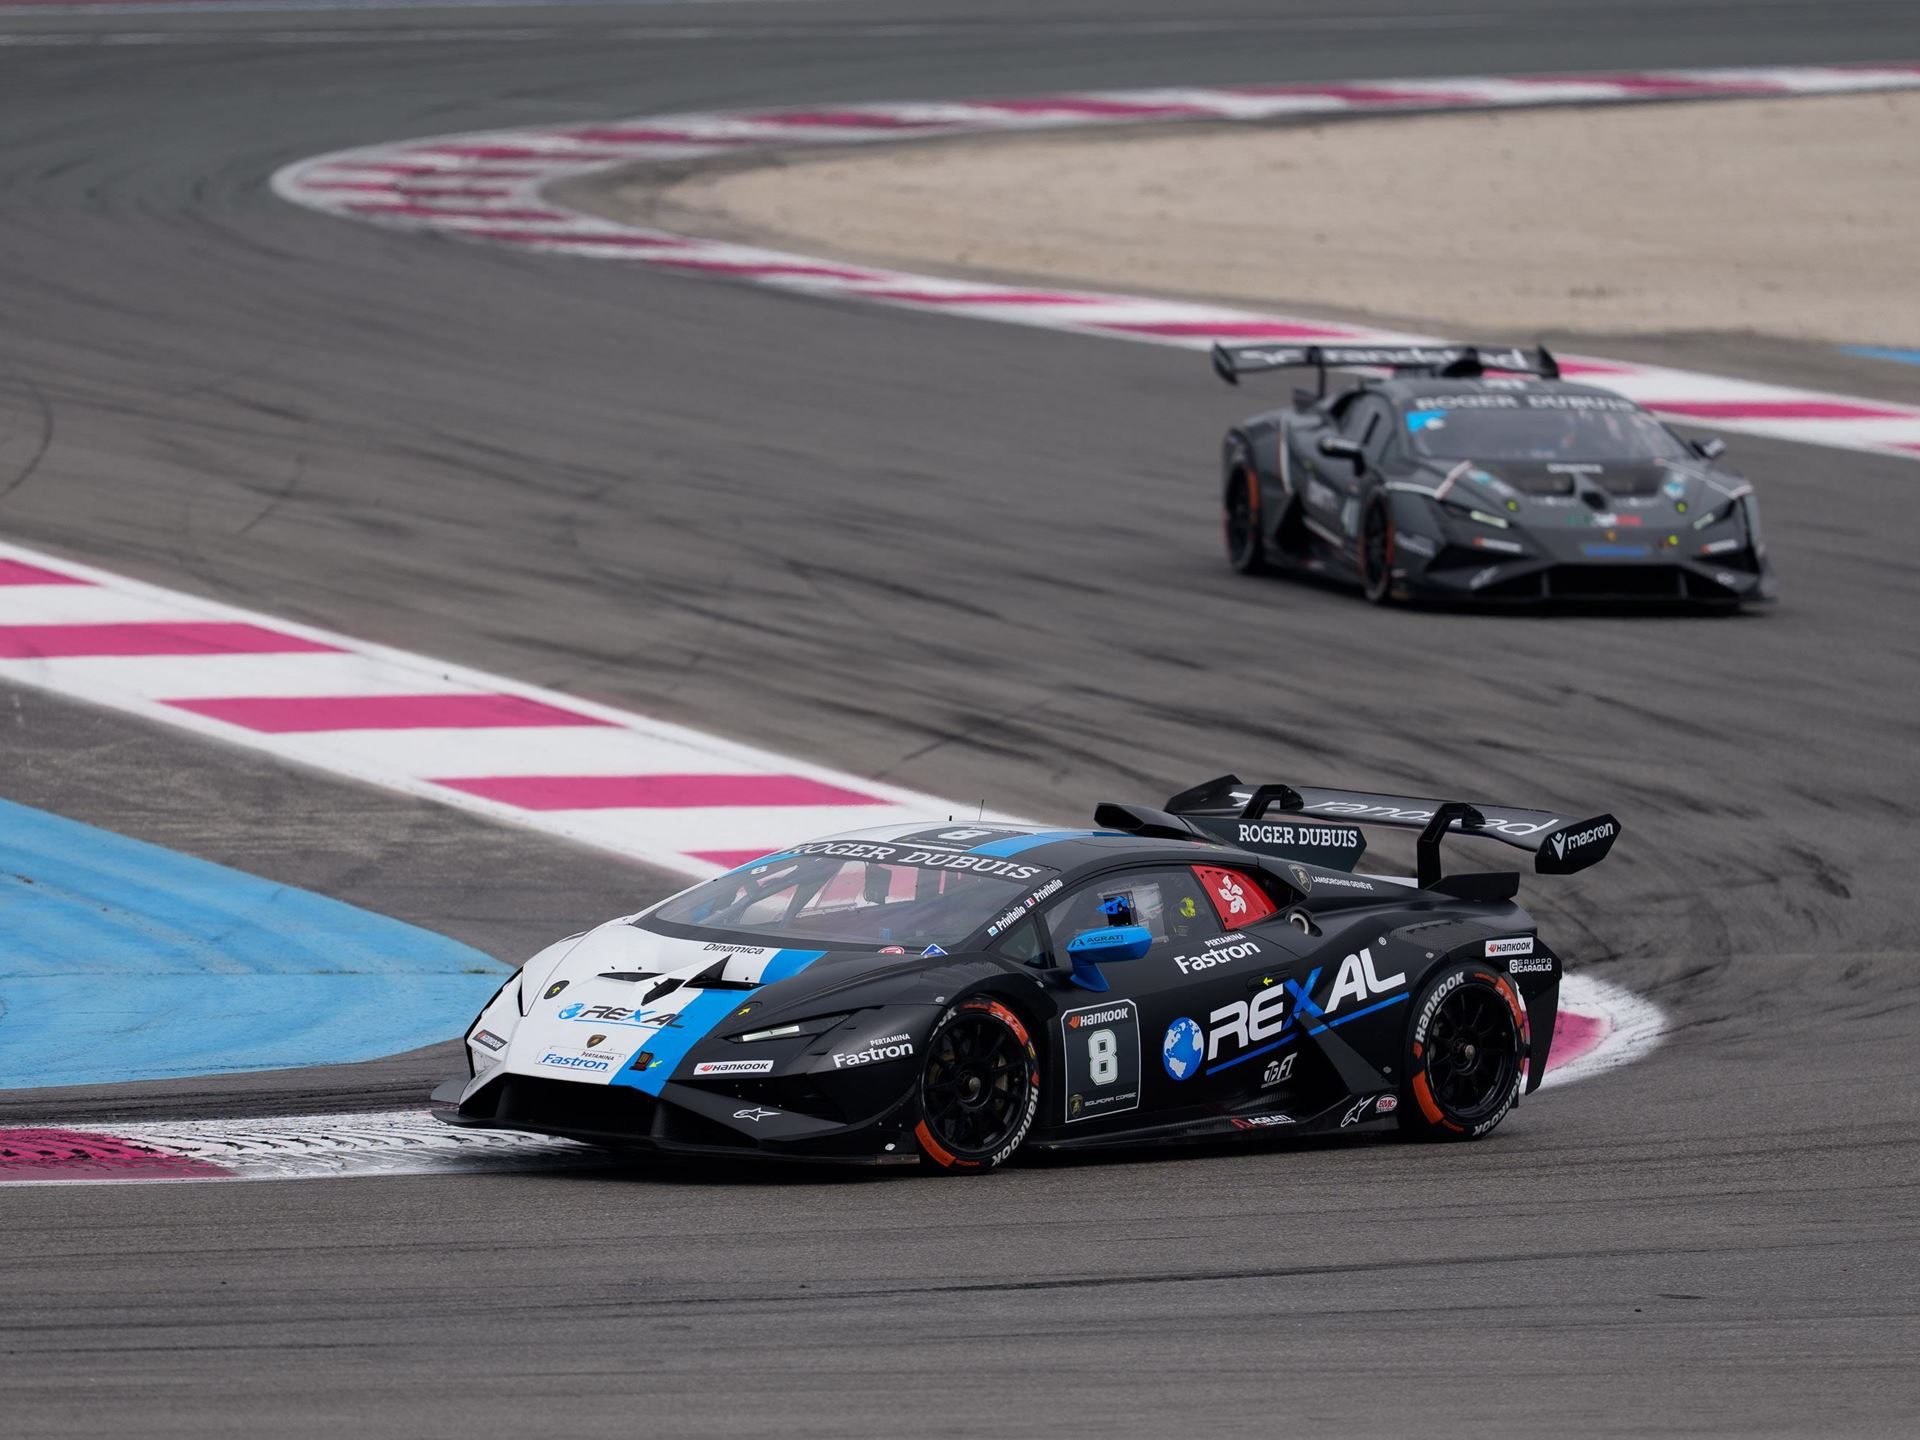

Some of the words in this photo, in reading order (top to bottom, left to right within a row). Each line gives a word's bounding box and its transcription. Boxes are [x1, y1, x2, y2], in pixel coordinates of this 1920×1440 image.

[1303, 801, 1560, 836] randad
[1238, 824, 1295, 845] ROGER
[1298, 828, 1358, 848] DUBUIS
[1567, 821, 1614, 850] macron
[785, 842, 896, 860] ROGER
[897, 850, 1040, 880] DUBUIS
[995, 905, 1026, 931] Privitello
[1032, 879, 1064, 902] Privitello
[702, 943, 765, 955] Dinamica
[1086, 934, 1124, 943] AGRATI
[1204, 932, 1246, 948] PERTAMINA
[1173, 941, 1262, 975] Fastron
[1518, 957, 1552, 966] GRUPPO
[1518, 964, 1552, 973] CARAGLIO
[1207, 948, 1407, 1061] REXAL
[578, 1005, 685, 1029] REXAL
[870, 1033, 911, 1047] PERTAMINA
[541, 1053, 609, 1071] Fastron
[581, 1051, 615, 1061] PERTAMINA
[832, 1042, 914, 1069] Fastron
[1087, 1028, 1119, 1086] 8
